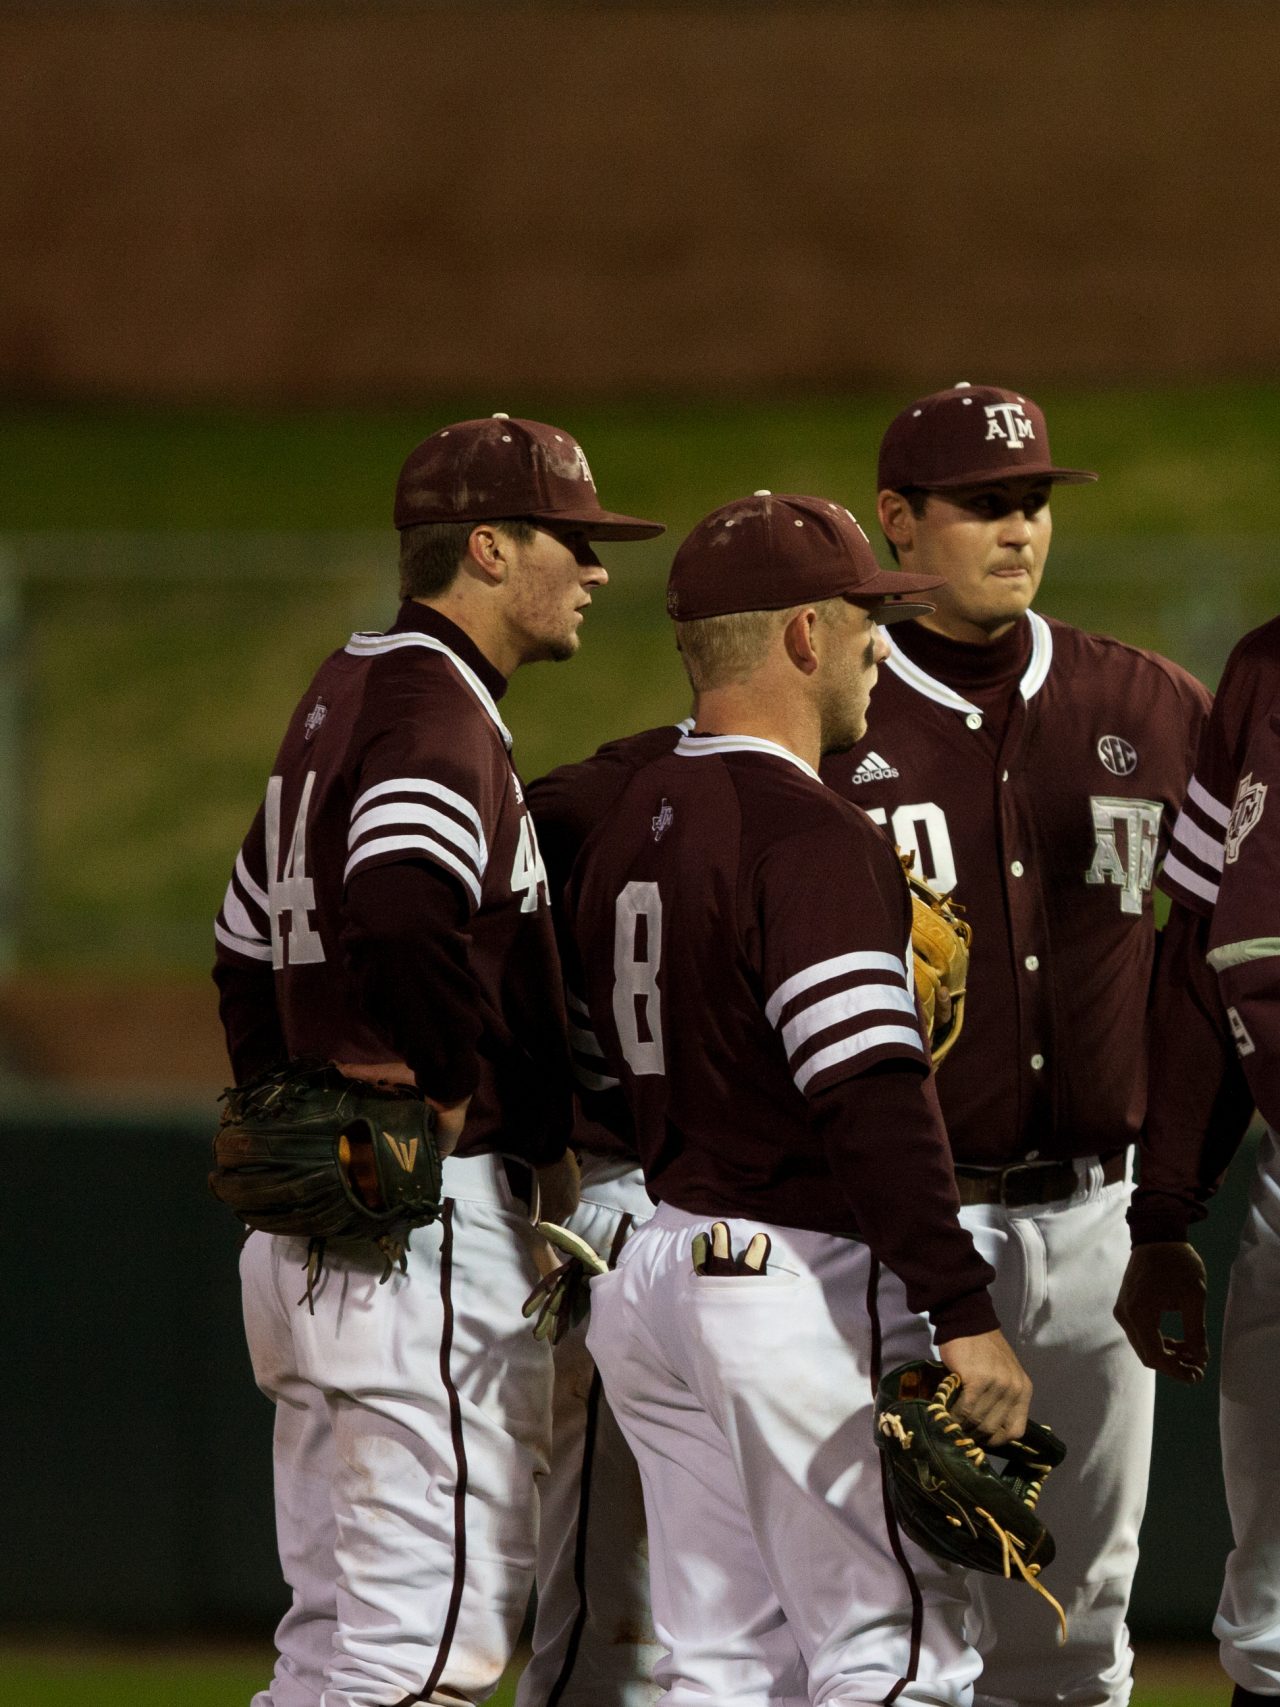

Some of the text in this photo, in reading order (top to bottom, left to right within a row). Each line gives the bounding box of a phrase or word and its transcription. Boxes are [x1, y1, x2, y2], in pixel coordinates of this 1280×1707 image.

[852, 767, 900, 785] adidas
[1098, 735, 1138, 776] SEC
[864, 802, 958, 899] 0
[612, 881, 666, 1077] 8
